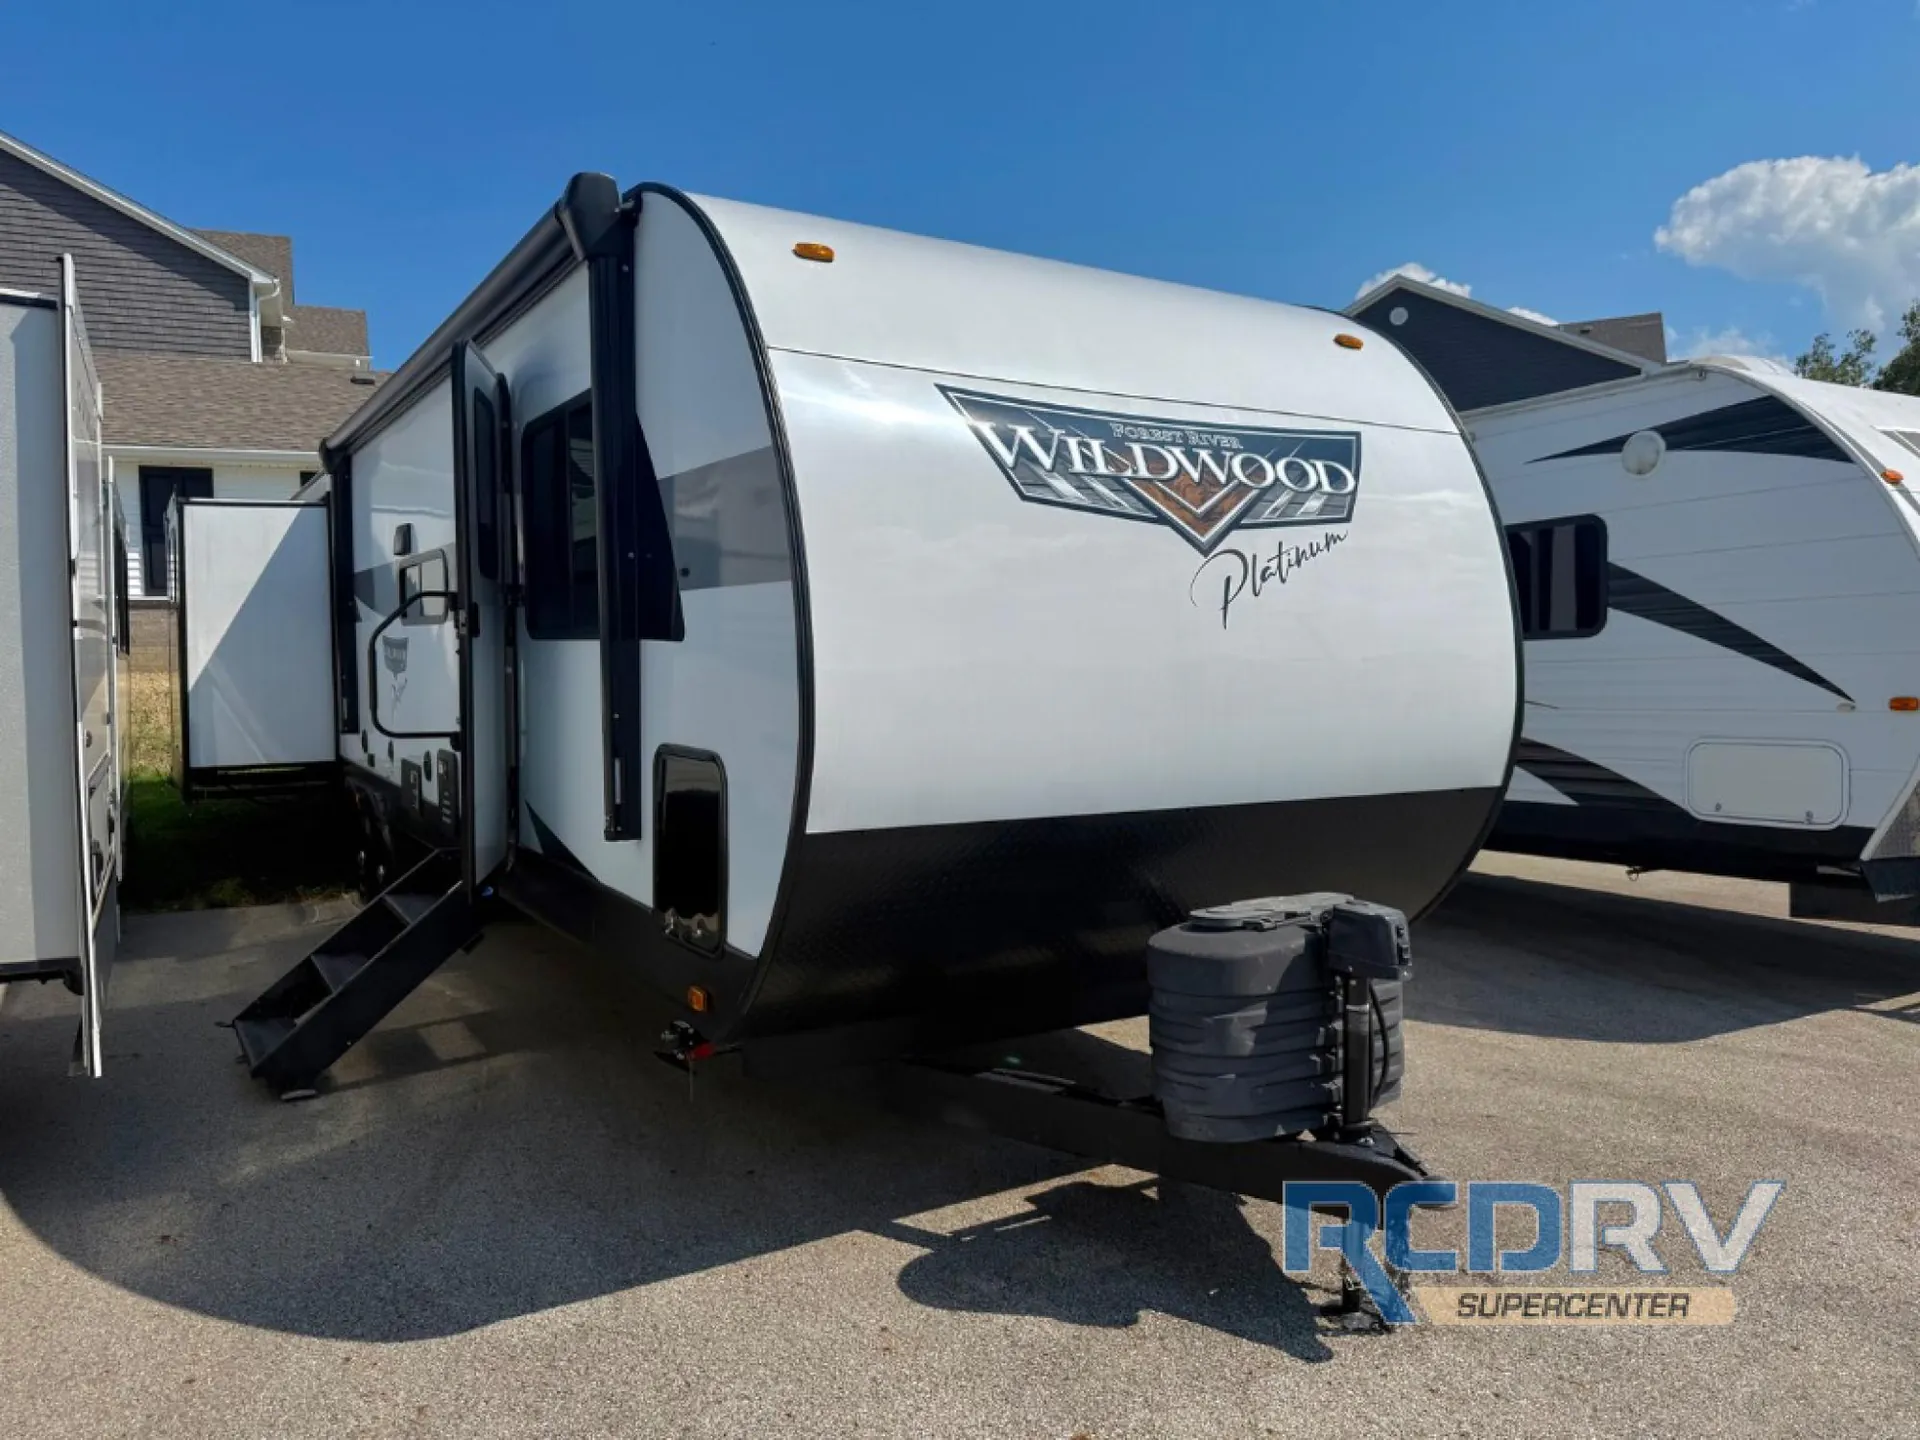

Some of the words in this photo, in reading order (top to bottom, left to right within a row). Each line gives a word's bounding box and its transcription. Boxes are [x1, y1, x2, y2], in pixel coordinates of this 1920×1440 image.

[968, 420, 1355, 494] WILDWOOD
[1110, 422, 1184, 443] FOREST
[1186, 430, 1243, 449] RIVER
[1190, 529, 1348, 629] Platinum
